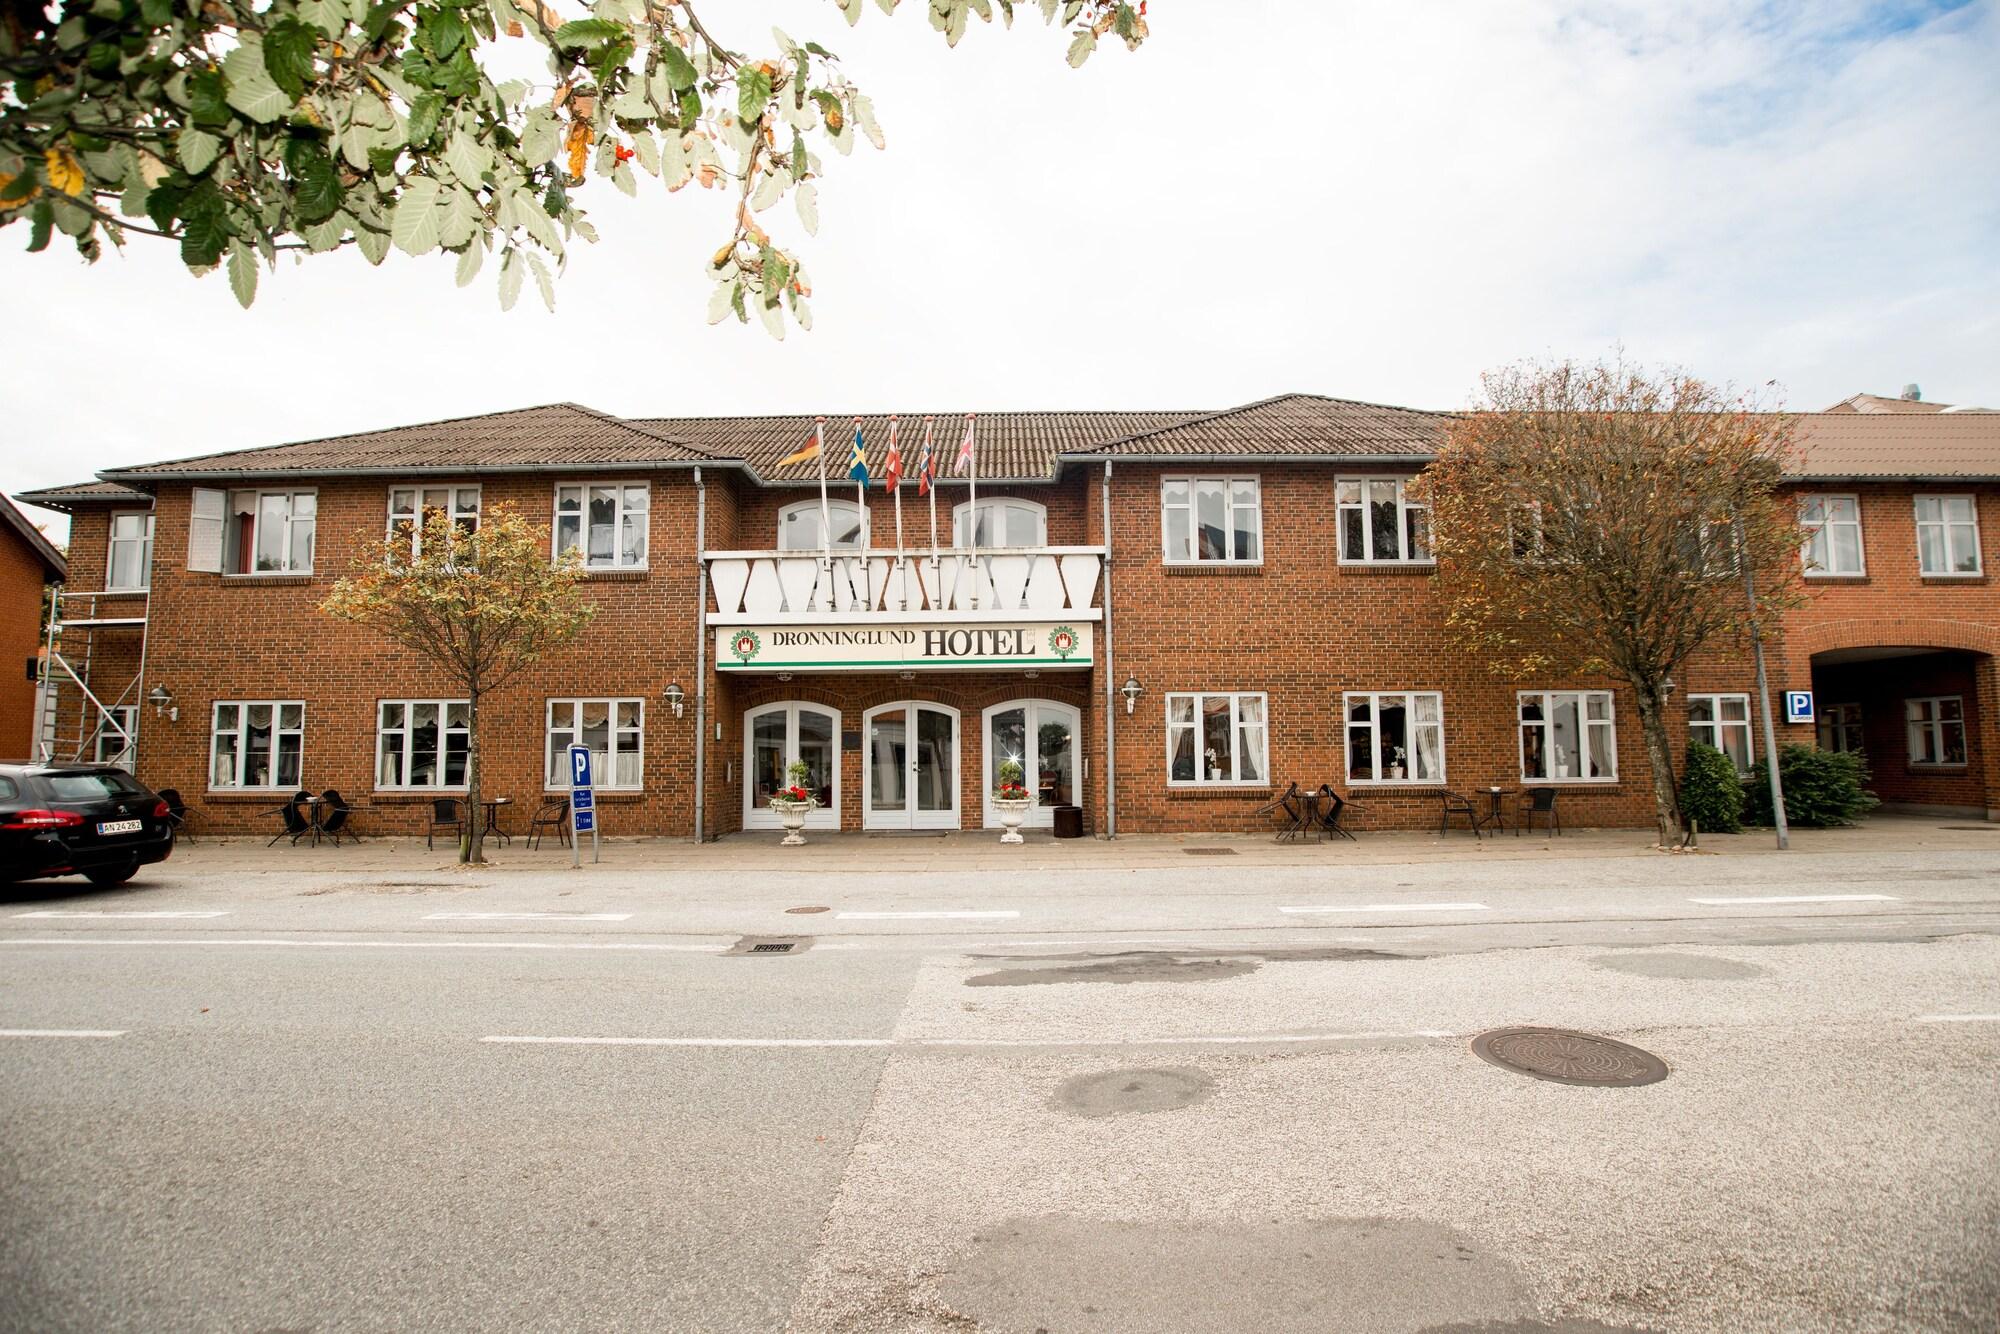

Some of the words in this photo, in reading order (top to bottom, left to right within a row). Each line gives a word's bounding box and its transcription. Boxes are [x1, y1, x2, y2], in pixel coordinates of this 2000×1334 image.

[773, 630, 916, 646] DRONNINGLUND
[922, 629, 1036, 656] HOTEL
[1793, 694, 1809, 715] P
[576, 753, 586, 782] P
[105, 823, 115, 831] AN
[116, 822, 127, 831] 24
[127, 821, 140, 829] 282
